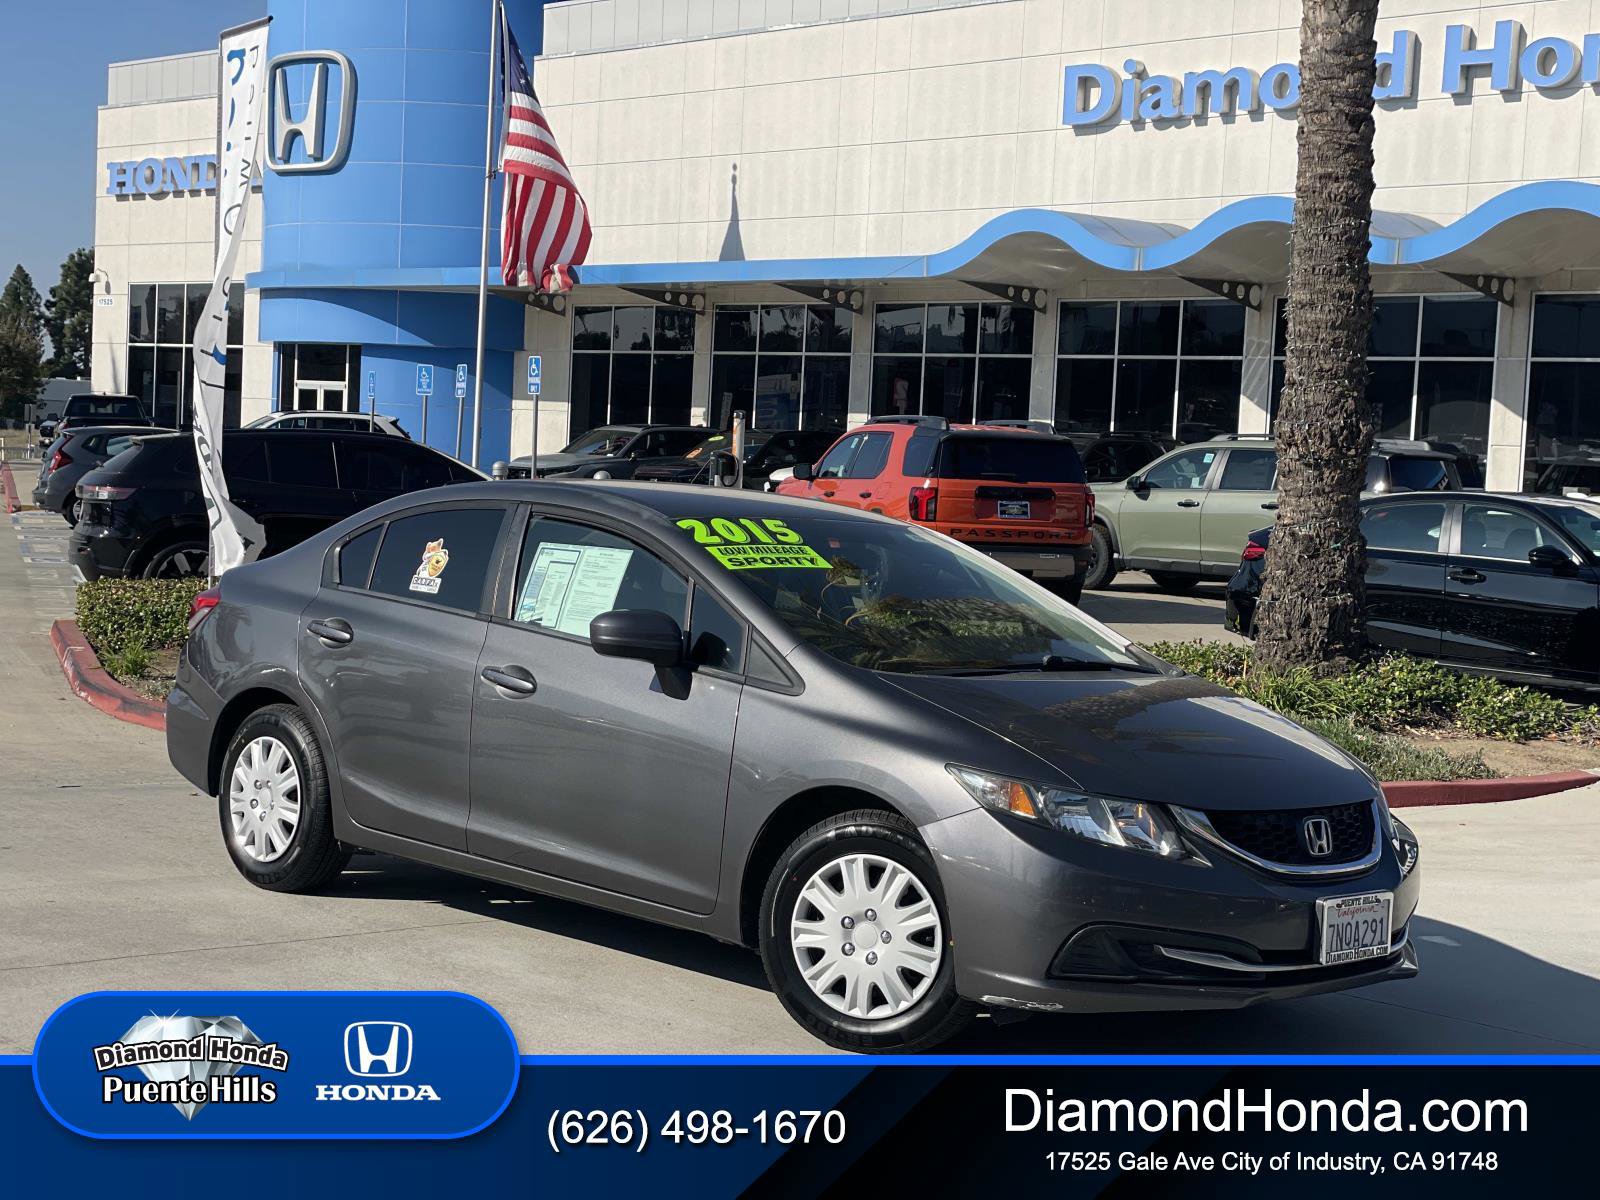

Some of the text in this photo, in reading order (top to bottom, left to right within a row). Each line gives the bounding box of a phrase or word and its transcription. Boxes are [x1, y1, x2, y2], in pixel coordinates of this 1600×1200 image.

[1062, 30, 1416, 126] Diamod
[676, 517, 804, 545] 2015
[950, 528, 1074, 540] PASSPORT
[716, 545, 809, 556] LOW MILEAGE
[726, 556, 818, 567] SPORTY
[1341, 897, 1362, 908] PUENTE
[1329, 917, 1385, 953] 7NQA291
